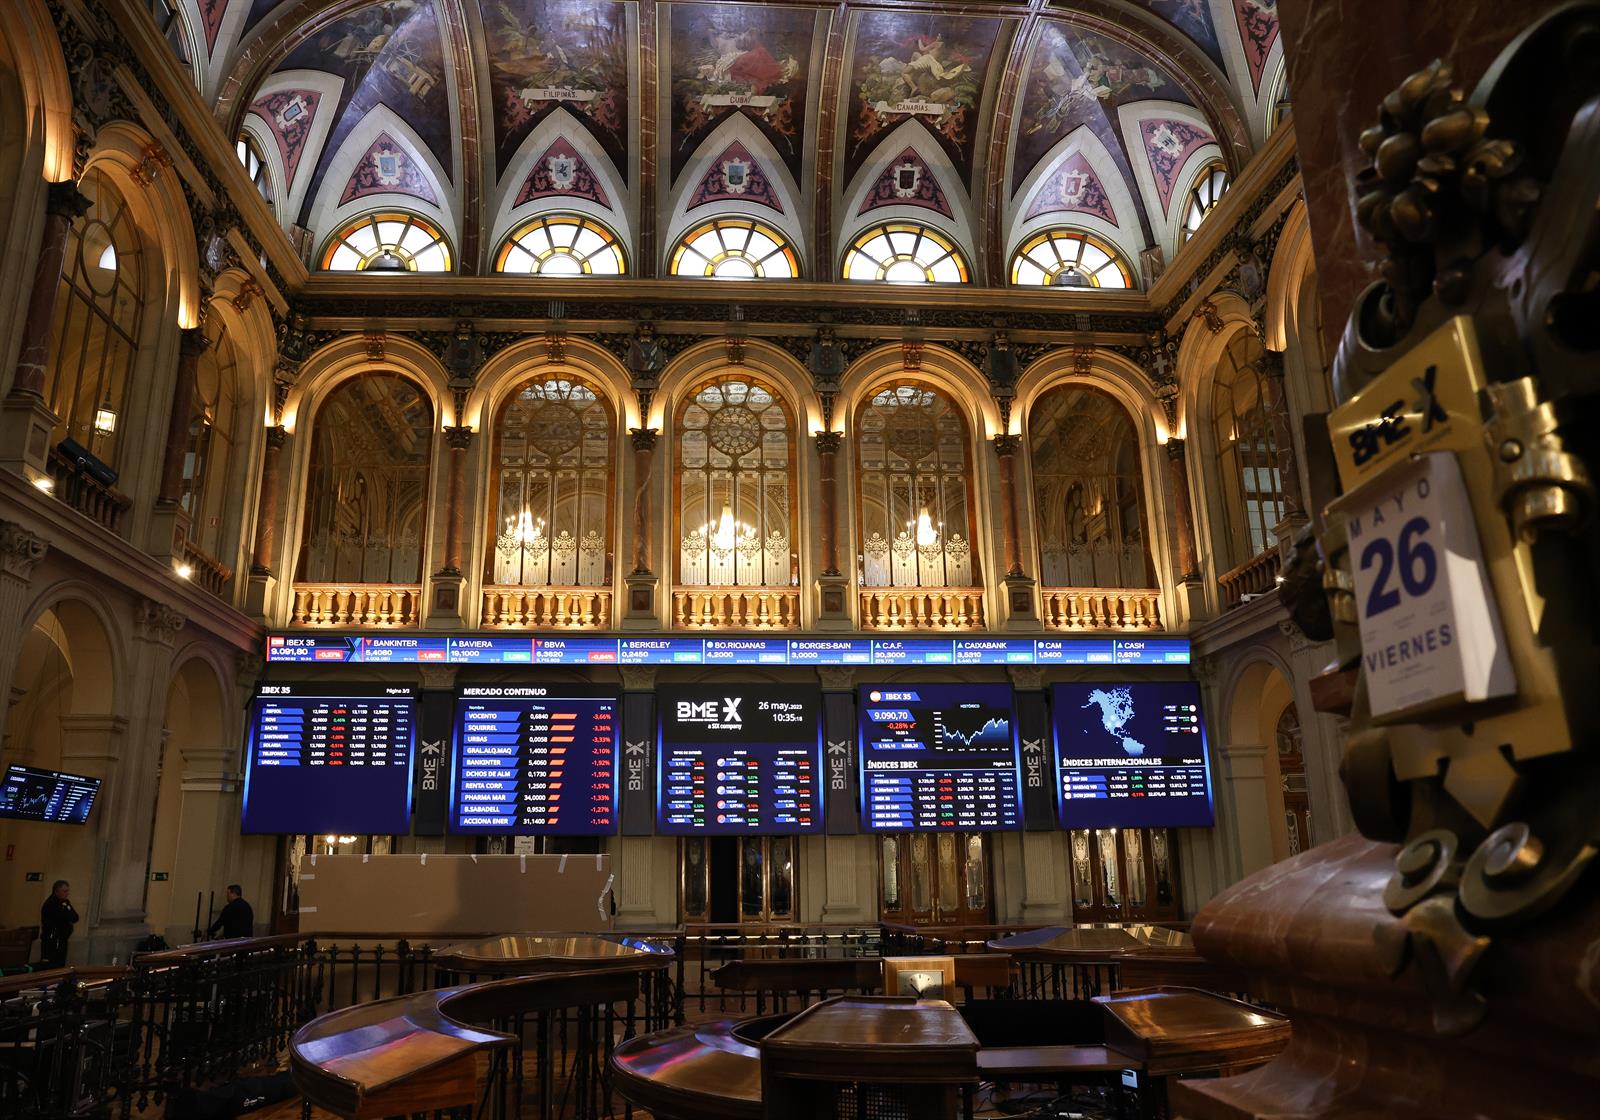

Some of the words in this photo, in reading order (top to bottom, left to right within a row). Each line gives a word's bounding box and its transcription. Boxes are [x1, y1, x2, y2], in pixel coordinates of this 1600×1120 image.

[1348, 400, 1410, 466] BME
[1350, 477, 1430, 540] MAYO
[1360, 516, 1437, 619] 26
[1366, 624, 1452, 674] VIERNES
[677, 702, 718, 717] BME
[875, 712, 907, 720] 9.090,70
[423, 758, 436, 790] BME
[629, 759, 641, 790] BME
[831, 758, 844, 789] BME
[868, 760, 899, 768] ÍNDICES
[1027, 756, 1040, 786] BME
